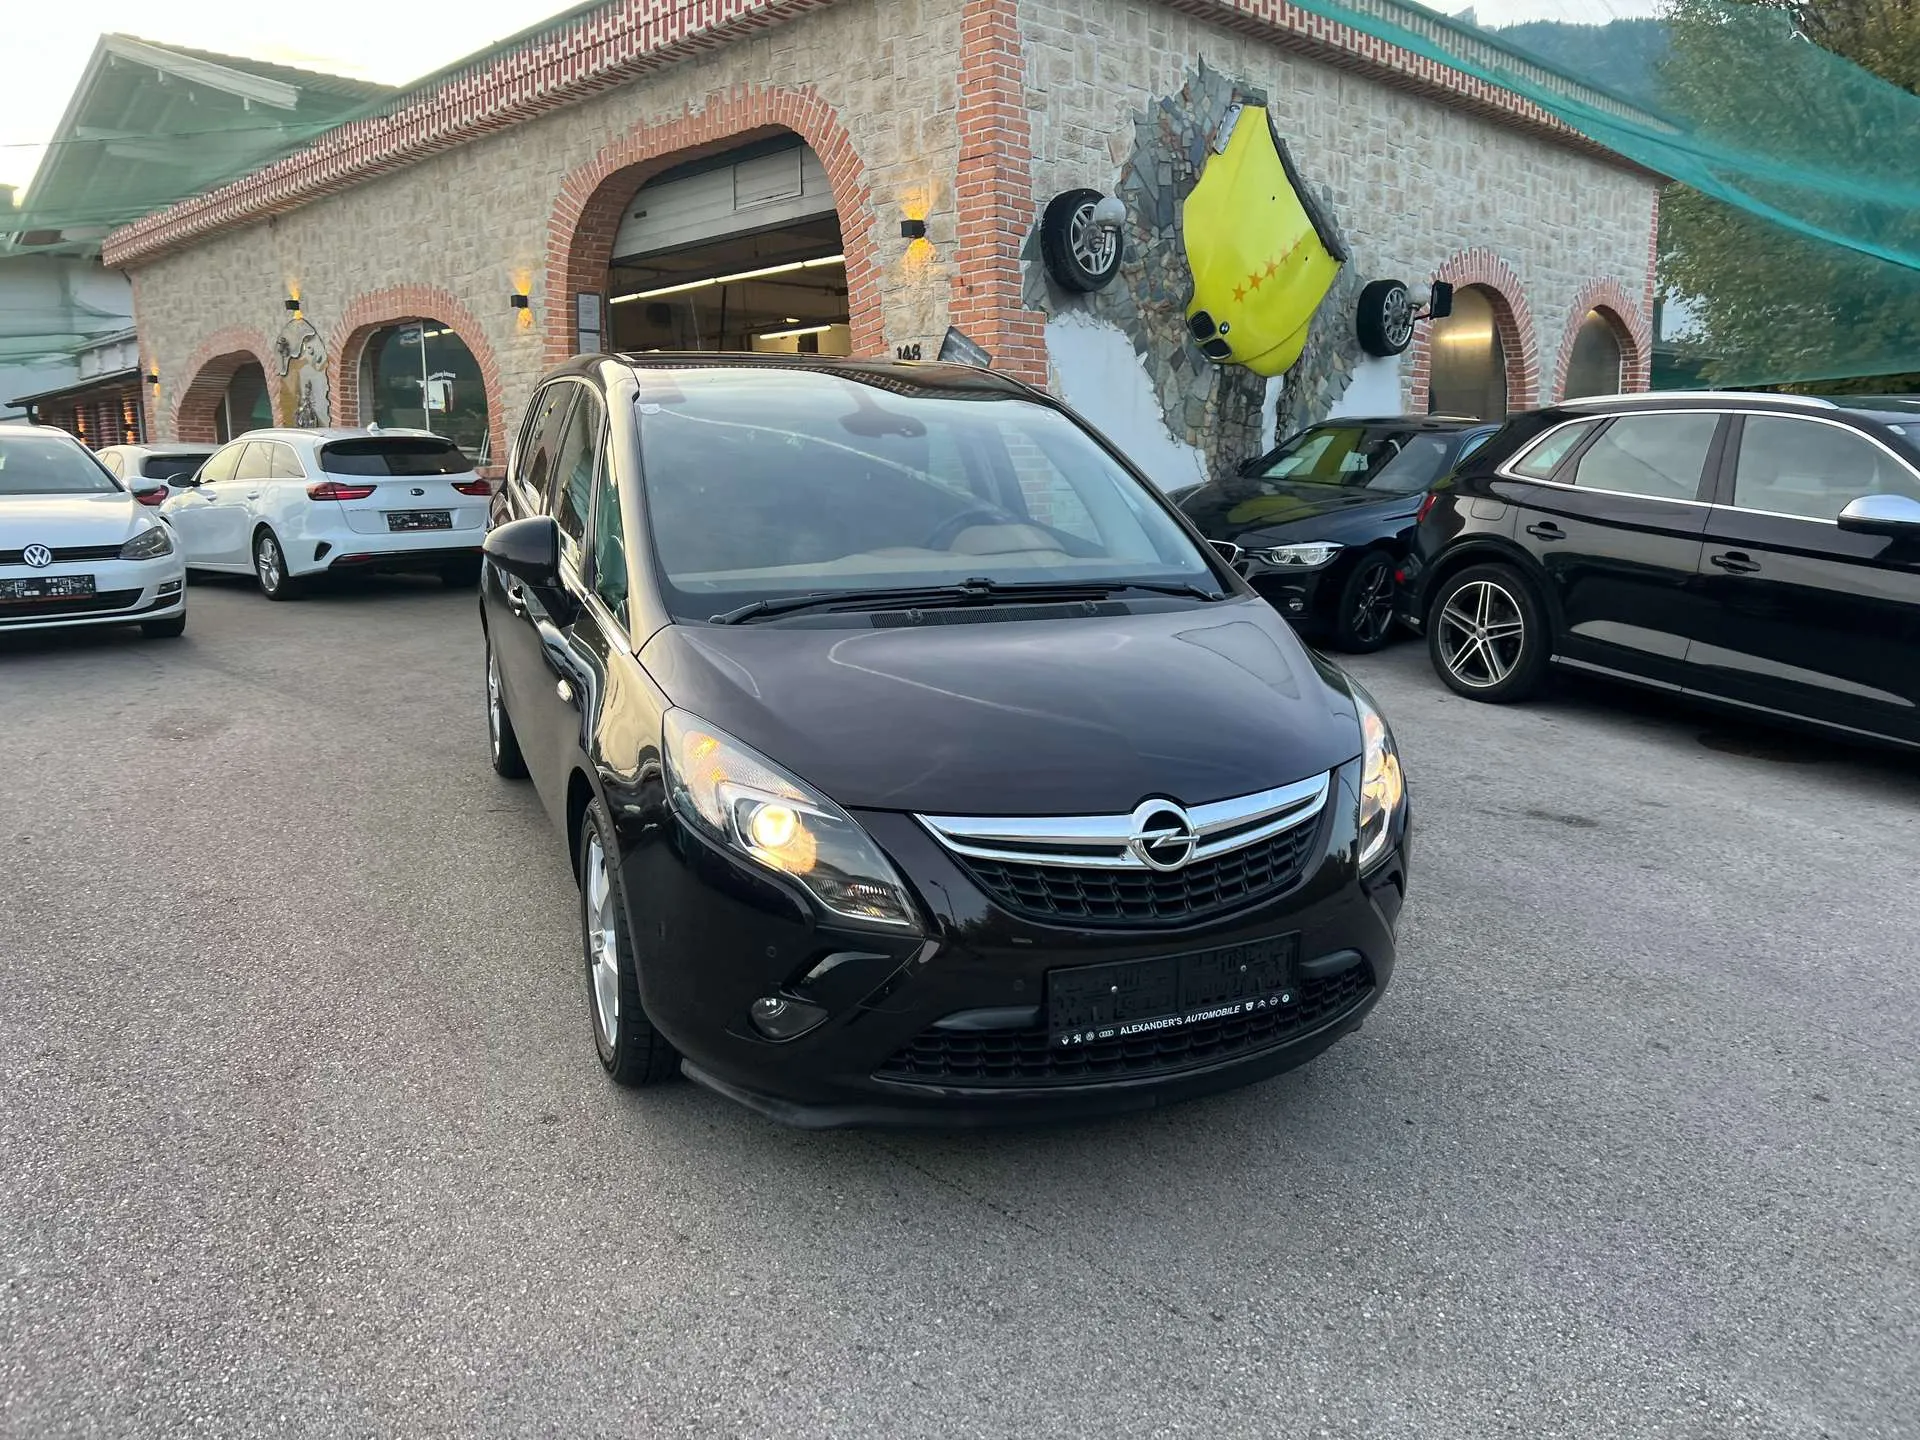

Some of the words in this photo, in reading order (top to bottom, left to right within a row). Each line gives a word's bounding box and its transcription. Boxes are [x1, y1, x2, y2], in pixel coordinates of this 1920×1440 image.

[897, 344, 921, 360] 148
[1120, 1017, 1183, 1035] ALEXANDER'S
[1184, 1005, 1241, 1024] AUTOMOBILE
